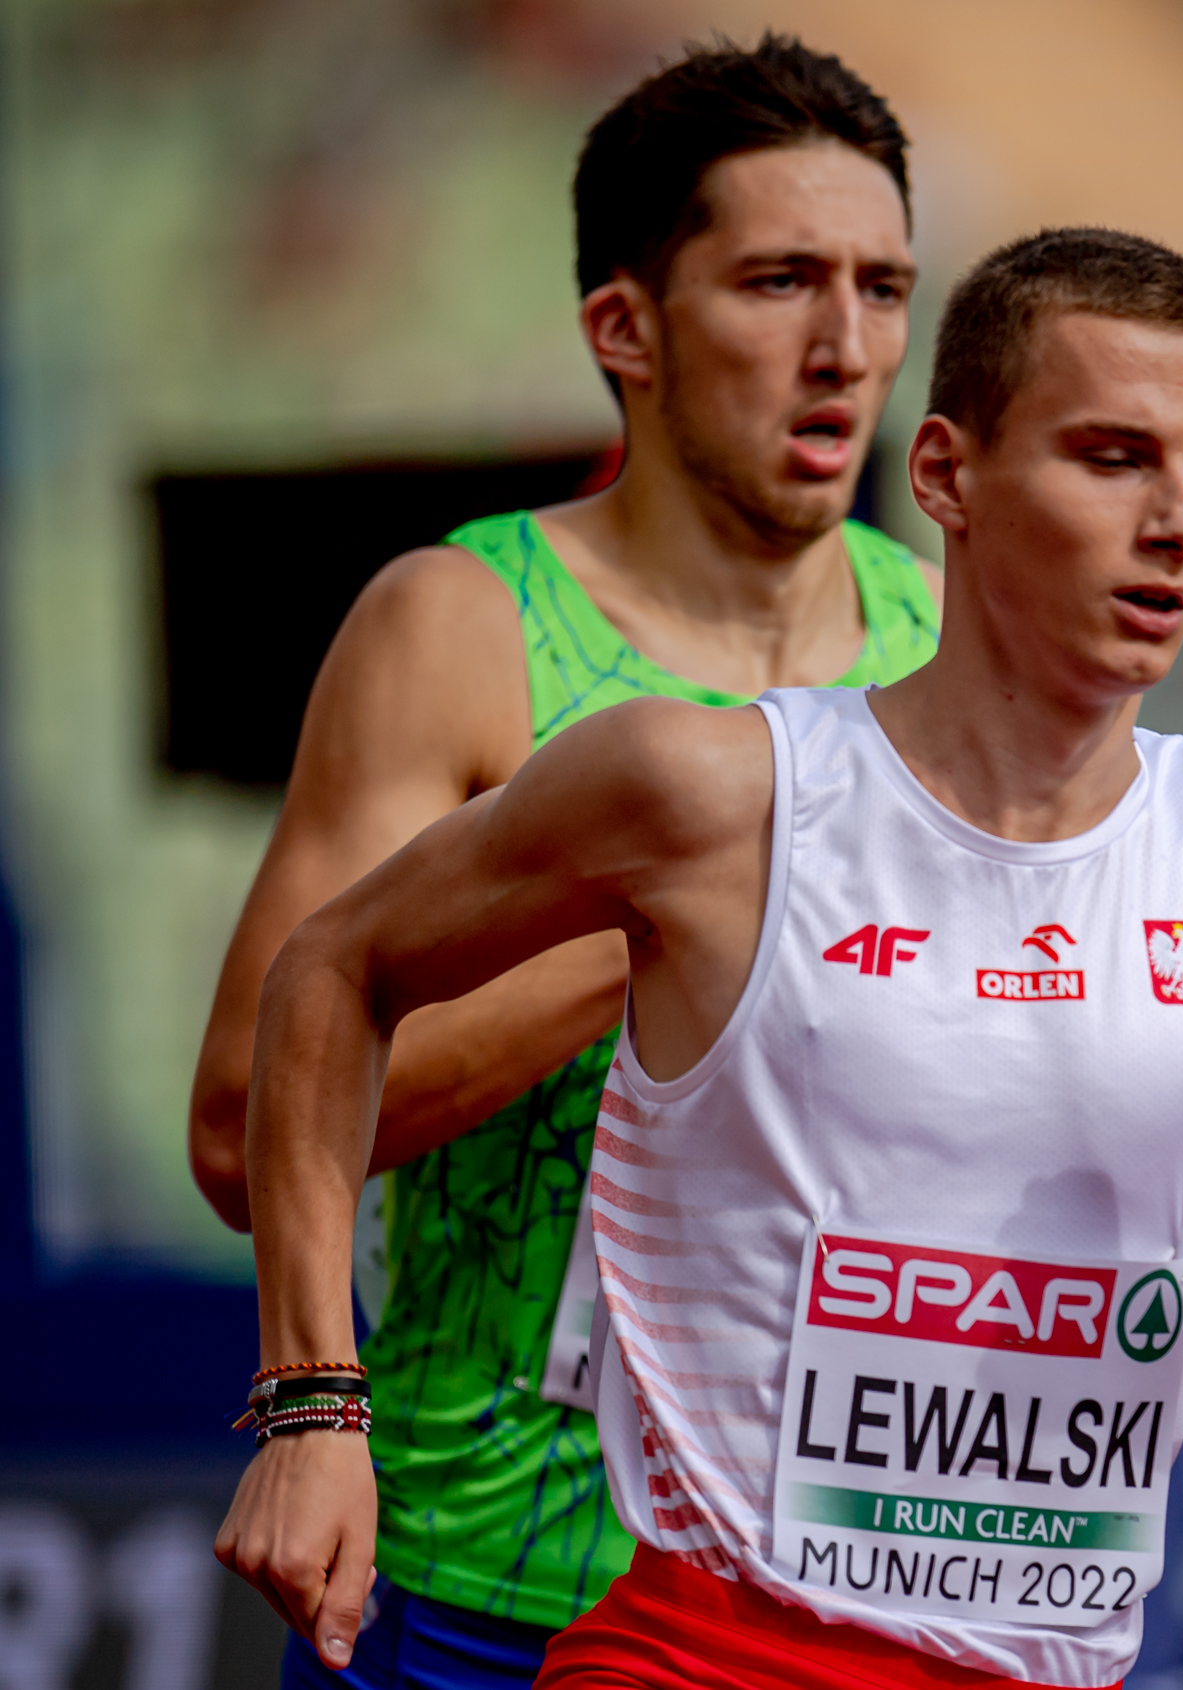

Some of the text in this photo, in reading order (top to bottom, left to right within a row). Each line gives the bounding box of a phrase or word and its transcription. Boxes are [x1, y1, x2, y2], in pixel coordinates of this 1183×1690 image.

[823, 924, 931, 977] 4F
[980, 972, 1080, 999] ORLEN
[818, 1249, 1106, 1344] SPAR
[796, 1369, 1164, 1489] LEWALSKI
[873, 1498, 883, 1527] I
[894, 1499, 966, 1536] RUN
[798, 1537, 1137, 1611] MUNICH 2022
